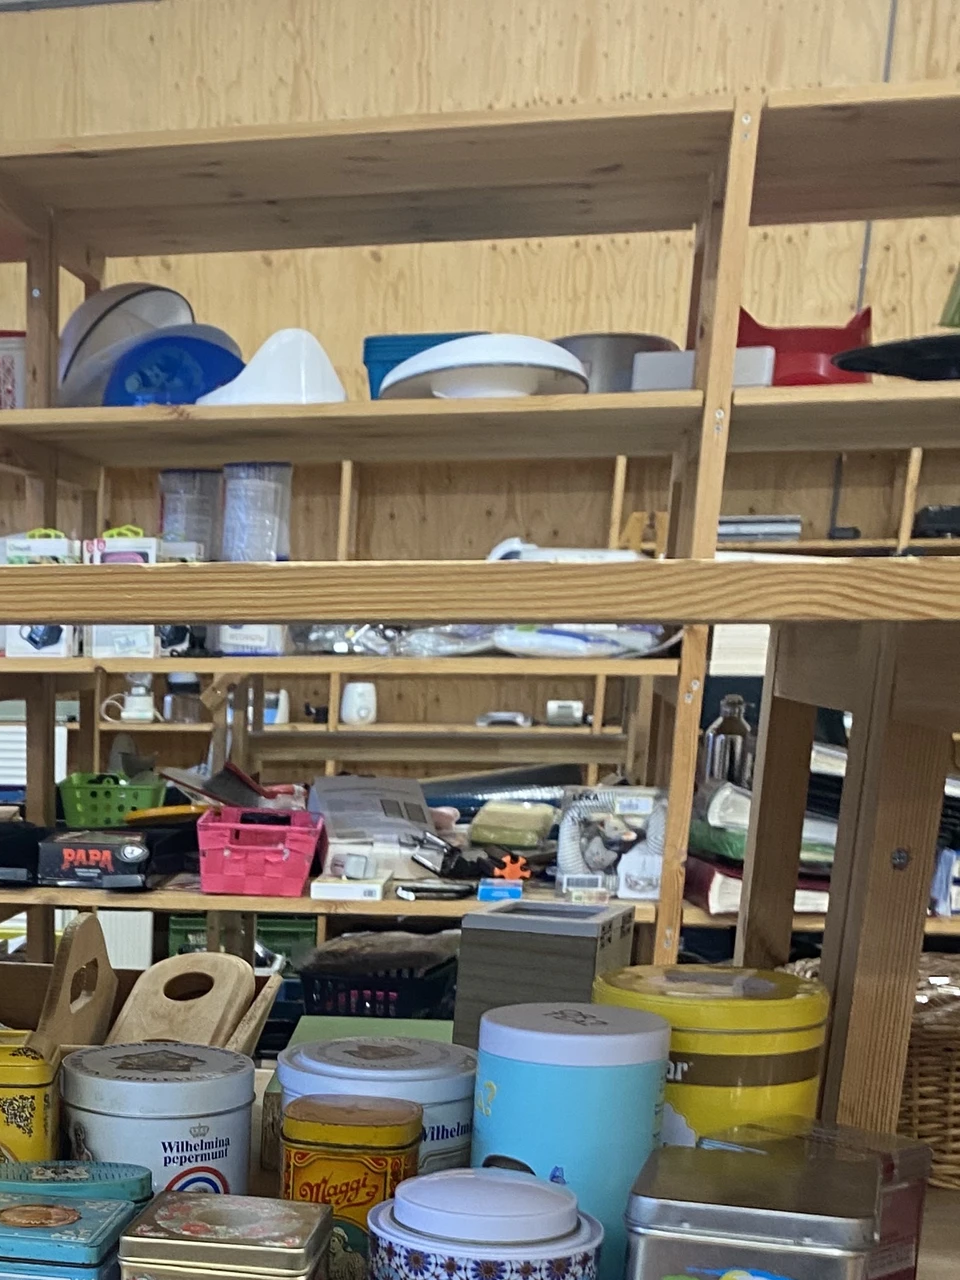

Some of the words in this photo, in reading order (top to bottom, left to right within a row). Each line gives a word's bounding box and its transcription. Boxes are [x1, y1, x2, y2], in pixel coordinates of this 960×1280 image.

[61, 848, 114, 873] PAPA
[161, 1137, 231, 1154] Wilhelmina
[163, 1148, 229, 1167] pepermunt
[299, 1171, 379, 1209] Maggi
